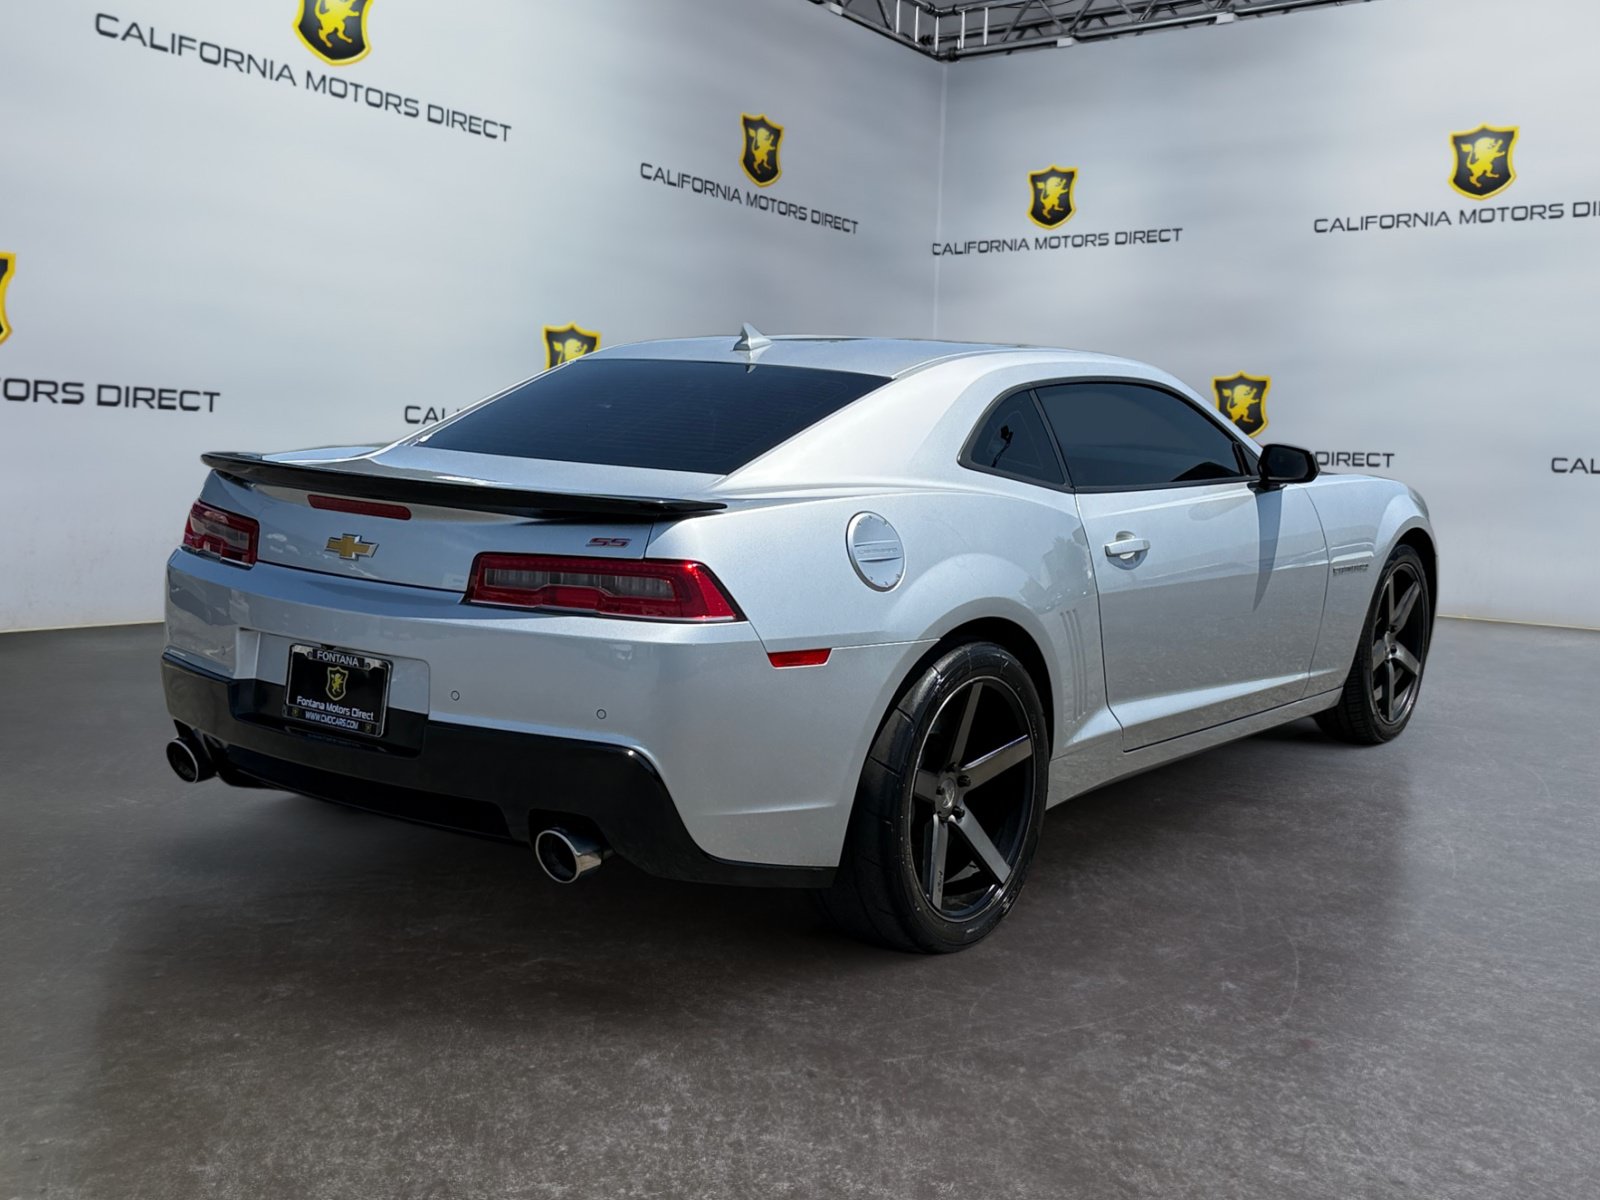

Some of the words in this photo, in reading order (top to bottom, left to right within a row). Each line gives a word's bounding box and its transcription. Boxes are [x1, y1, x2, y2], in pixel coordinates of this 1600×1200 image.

[94, 12, 298, 87] CALIFORNIA
[305, 69, 420, 119] MOTORS
[426, 103, 513, 143] DIRECT
[639, 162, 743, 205] CALIFORNIA
[745, 191, 808, 222] MOTORS
[810, 208, 859, 234] DIRECT
[1313, 210, 1453, 234] CALIFORNIA
[1458, 202, 1565, 225] MOTORS
[1571, 200, 1600, 218] DI
[931, 238, 1031, 256] CALIFORNIA
[1034, 232, 1110, 251] MOTORS
[1114, 227, 1184, 246] DIRECT
[0, 377, 86, 406] ORS
[95, 383, 222, 413] DIRECT
[1315, 450, 1396, 469] DIRECT
[585, 537, 632, 548] SS
[316, 650, 359, 667] FONTANA
[296, 695, 325, 710] Fontana
[326, 702, 350, 716] Motors
[351, 707, 374, 721] Direct
